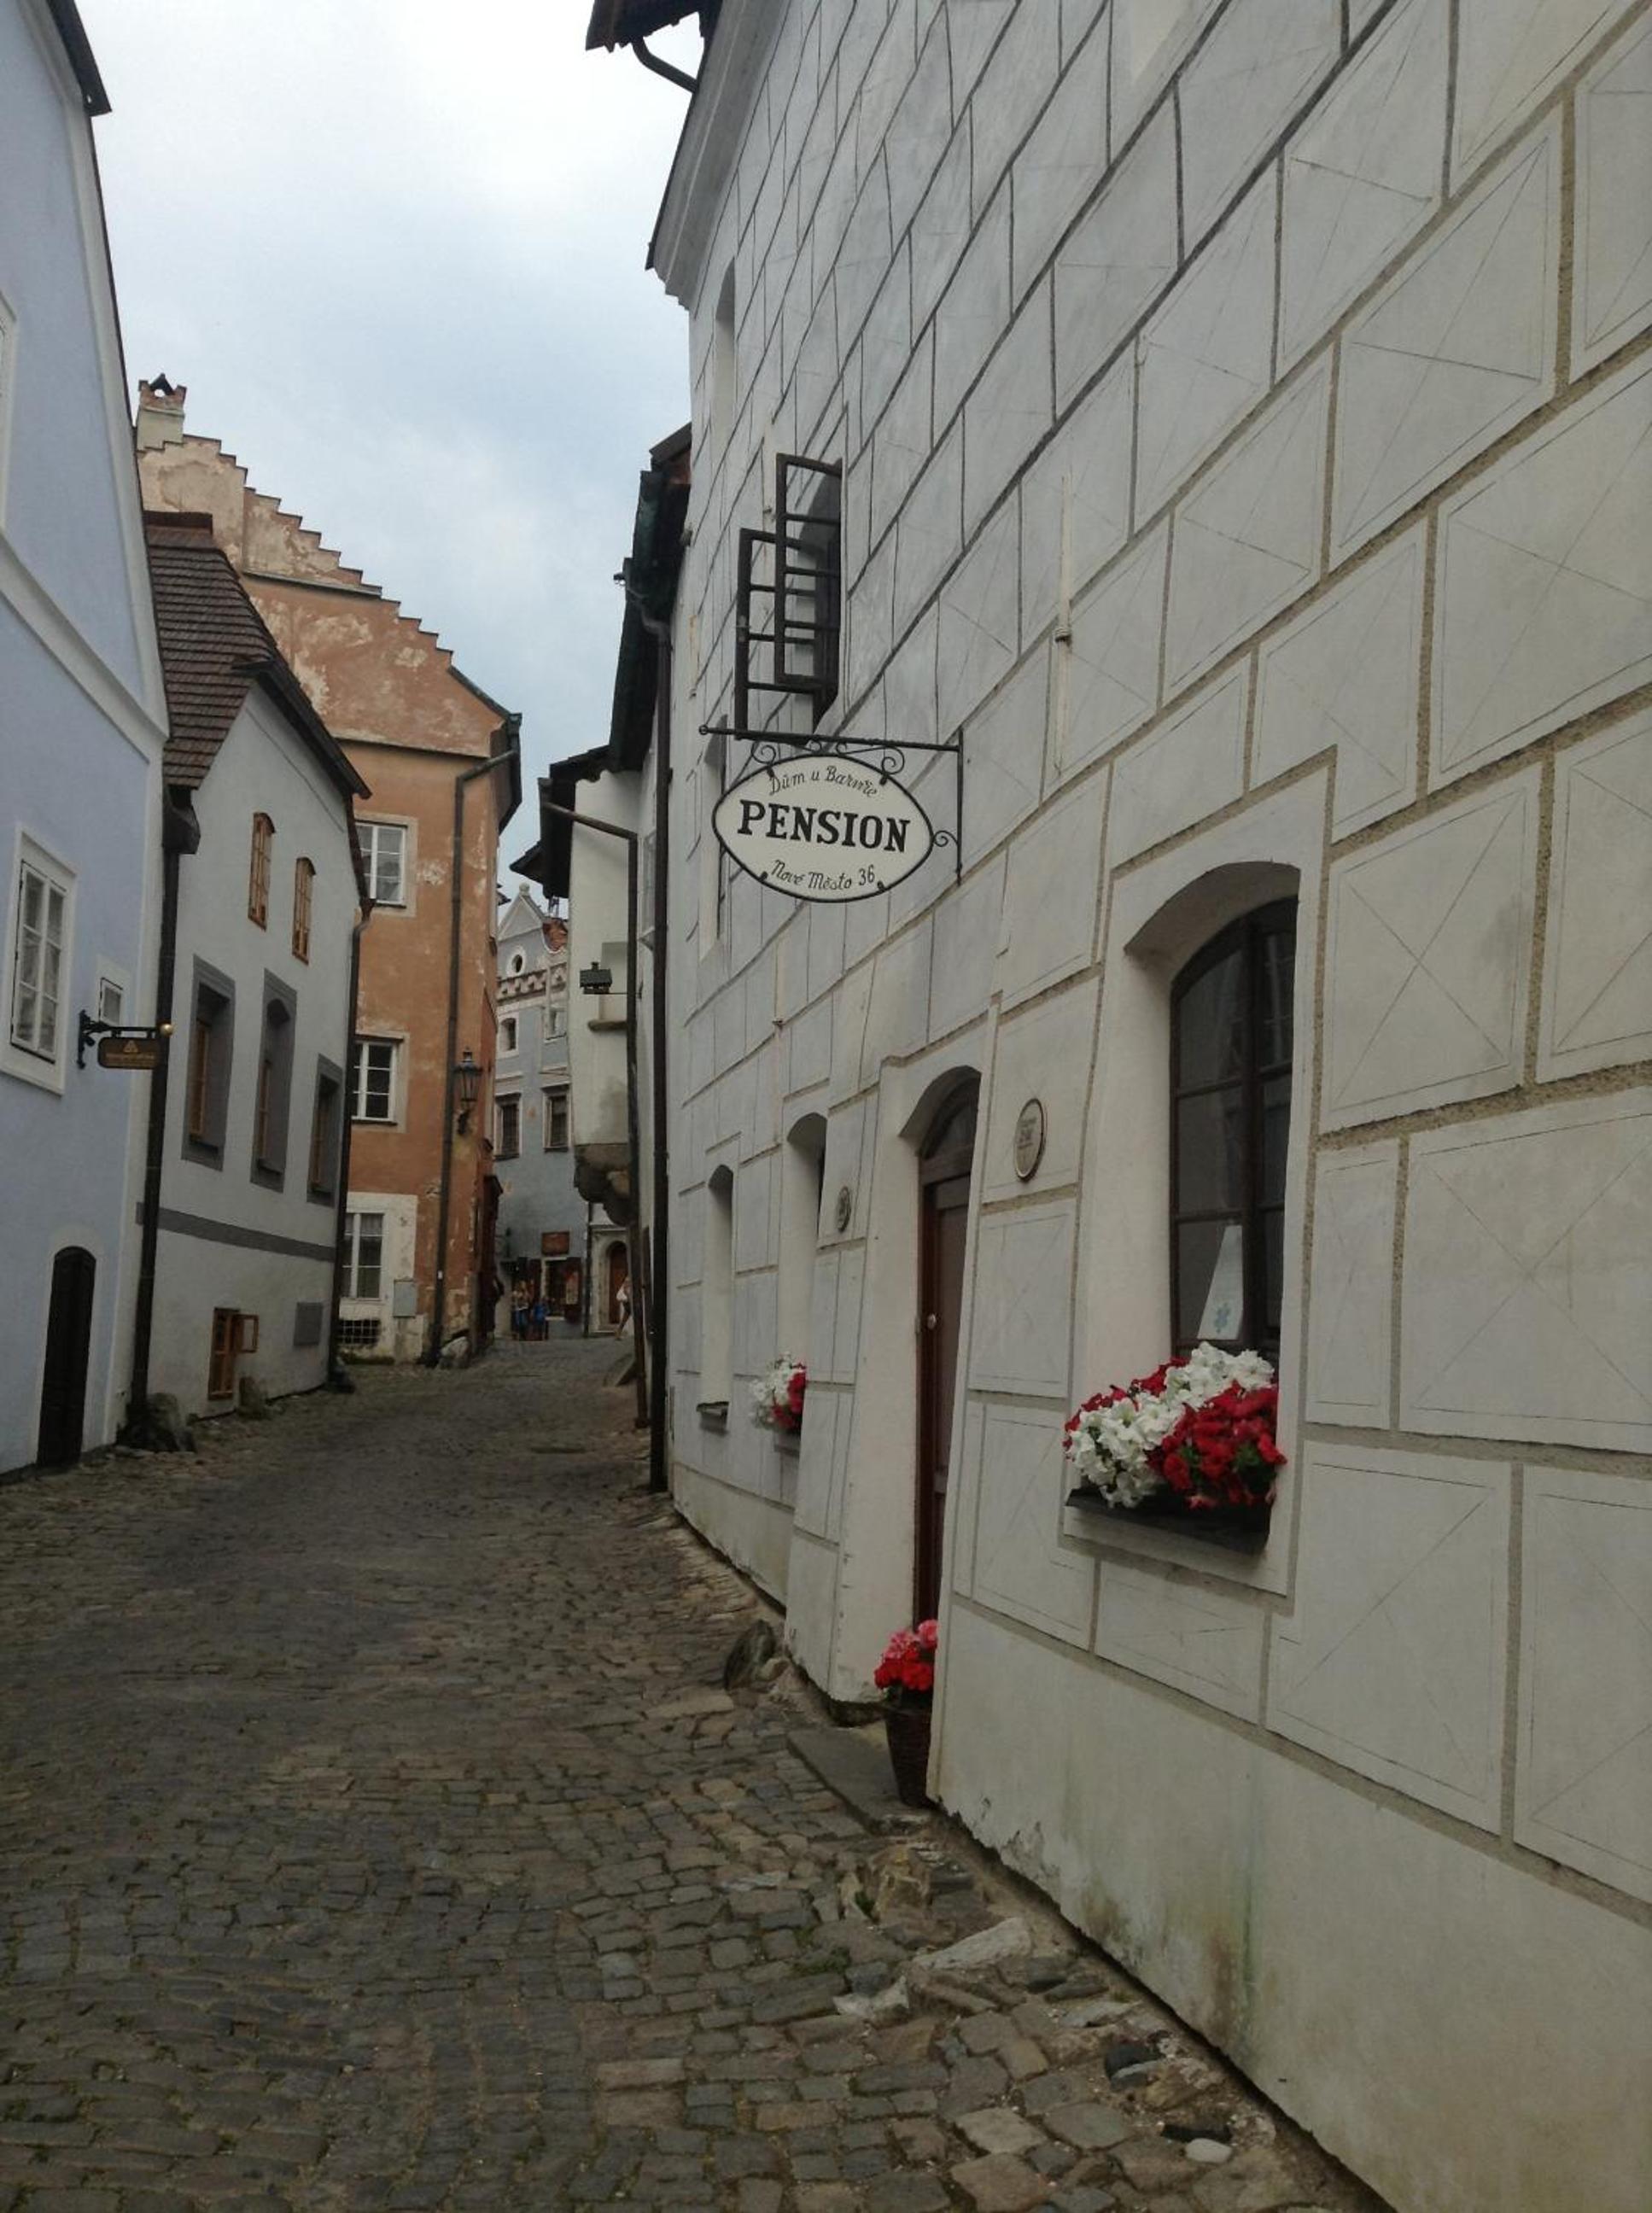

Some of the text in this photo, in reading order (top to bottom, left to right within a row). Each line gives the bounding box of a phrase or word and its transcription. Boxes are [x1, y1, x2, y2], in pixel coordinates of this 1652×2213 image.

[811, 770, 820, 781] u
[737, 799, 911, 853] PENSION
[771, 859, 876, 890] Nové Město 36
